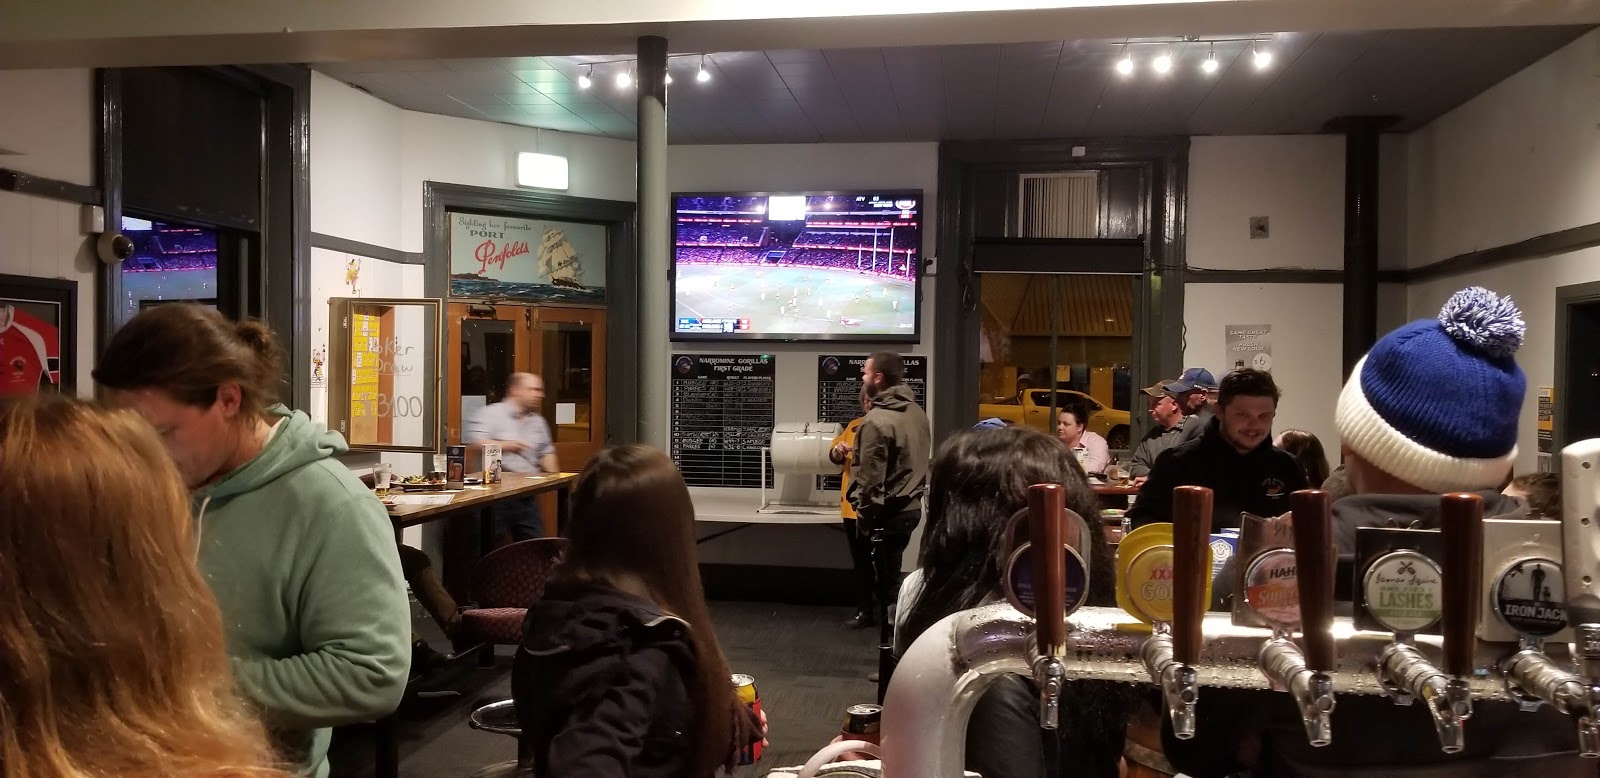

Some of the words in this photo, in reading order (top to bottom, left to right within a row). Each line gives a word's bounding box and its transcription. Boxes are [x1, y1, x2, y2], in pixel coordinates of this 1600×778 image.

[458, 216, 487, 230] Sighting
[489, 219, 501, 228] her
[503, 221, 532, 232] favourite
[475, 239, 529, 274] Penfolds
[373, 358, 414, 373] Draw
[698, 357, 736, 366] NARROMINE
[738, 357, 769, 365] GORILLAS
[848, 359, 867, 367] NARR
[732, 365, 754, 373] GRADE
[1150, 568, 1174, 580] XXX
[1375, 573, 1405, 584] James
[1408, 574, 1438, 586] Squire
[1379, 591, 1434, 609] LASHES
[1504, 604, 1536, 617] IRON
